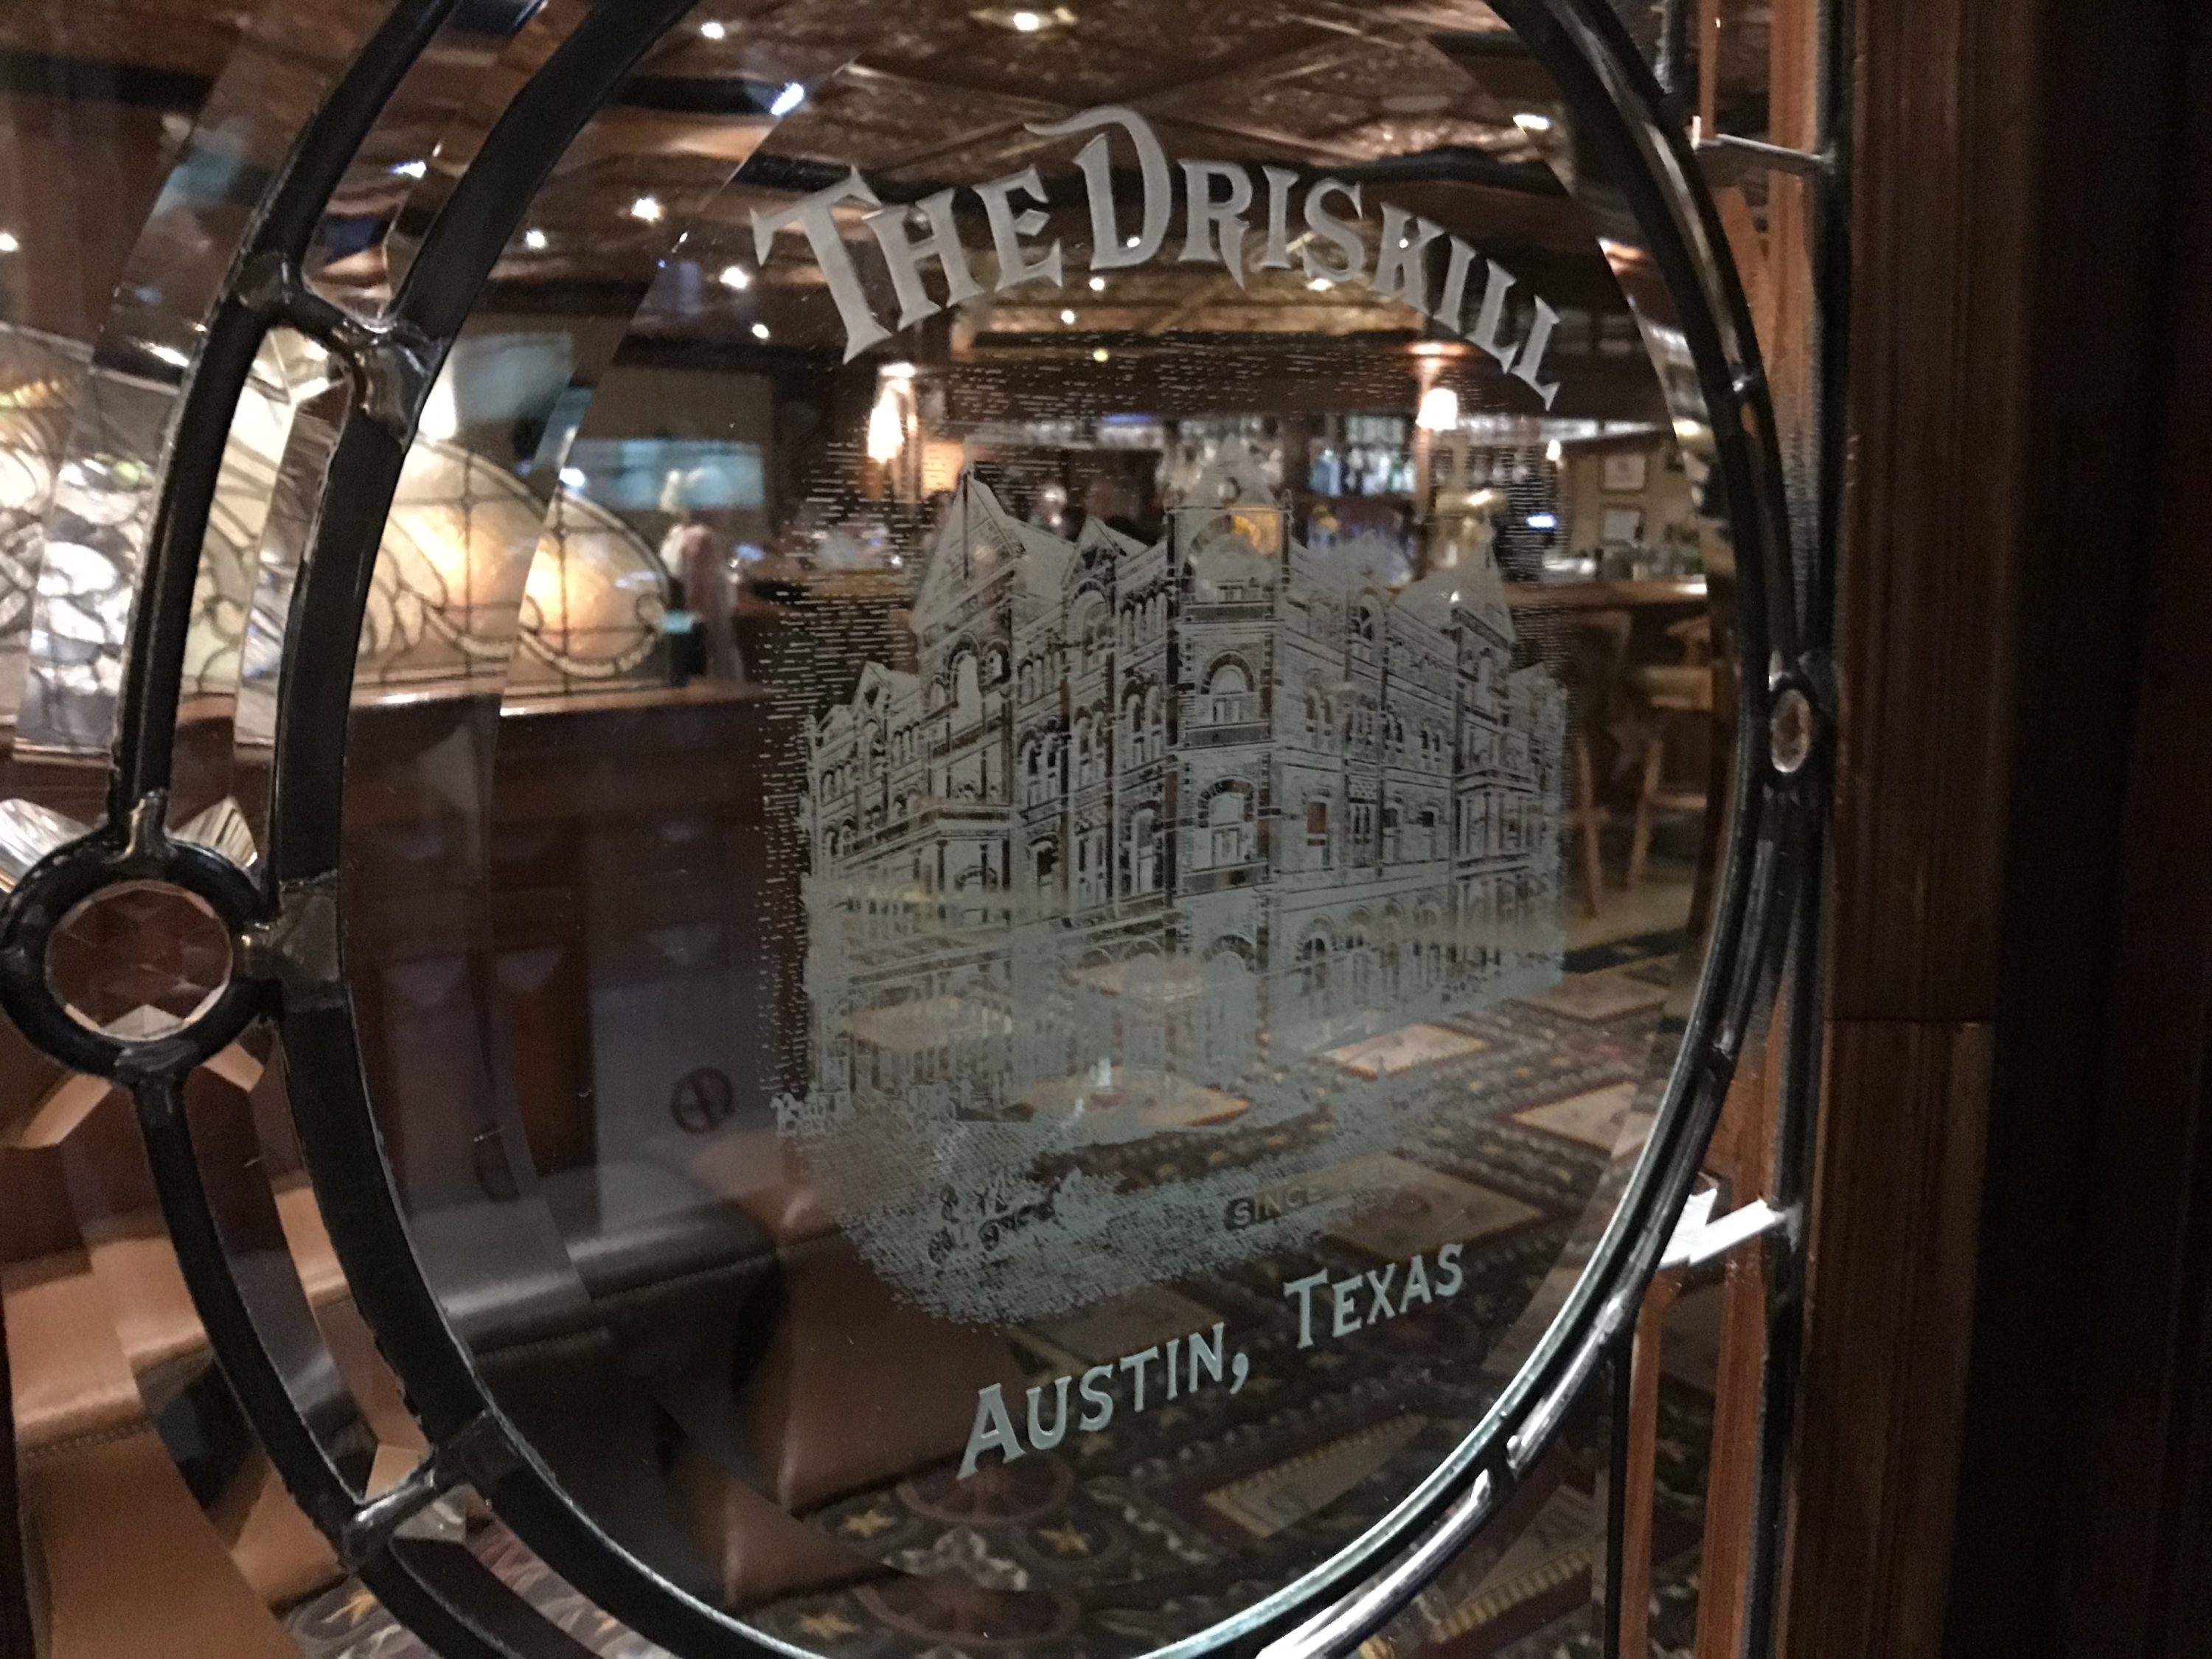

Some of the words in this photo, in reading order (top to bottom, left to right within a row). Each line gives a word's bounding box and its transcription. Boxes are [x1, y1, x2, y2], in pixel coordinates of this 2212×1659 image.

[750, 163, 1062, 365] THE
[1024, 104, 1561, 412] DRISKILL
[1232, 1182, 1323, 1225] SINCE
[957, 1321, 1250, 1481] AUSTIN,
[1283, 1243, 1464, 1349] TEXAS
